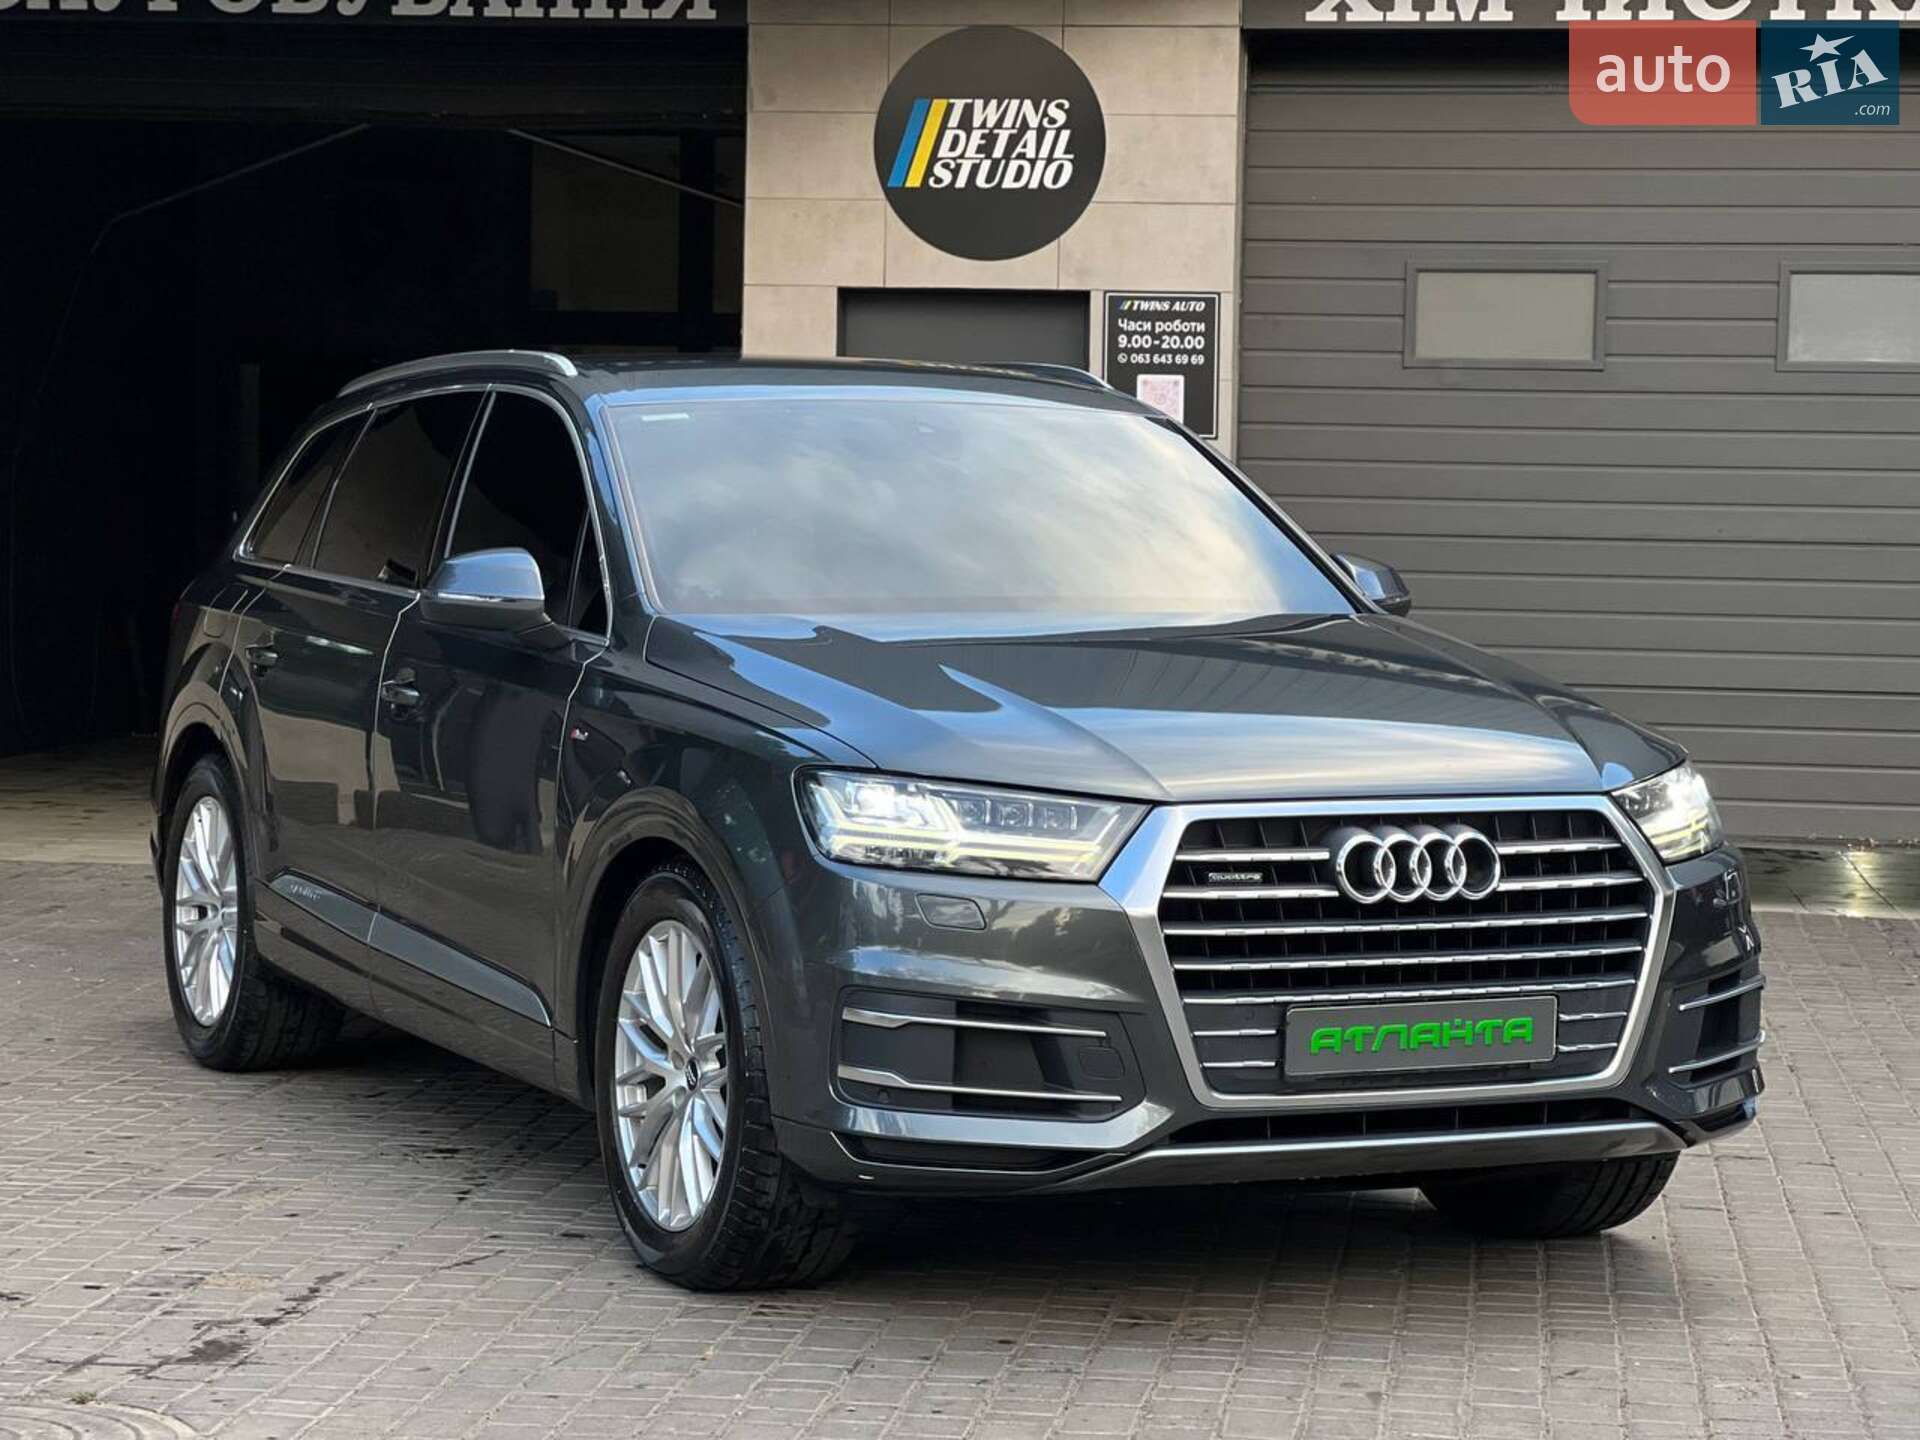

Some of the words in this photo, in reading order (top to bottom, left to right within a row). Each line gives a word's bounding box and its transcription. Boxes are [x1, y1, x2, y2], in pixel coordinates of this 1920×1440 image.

[947, 98, 1070, 128] TWINS
[937, 129, 1075, 159] DETAIL
[928, 159, 1074, 190] STUDIO
[1131, 300, 1170, 312] TWINS
[1171, 300, 1206, 312] AUTO
[1117, 317, 1152, 332] Часи
[1155, 318, 1206, 337] роботи
[1117, 334, 1206, 350] 9.00-20.00
[1130, 353, 1151, 365] 063
[1174, 353, 1189, 365] 69
[1190, 353, 1206, 366] 69
